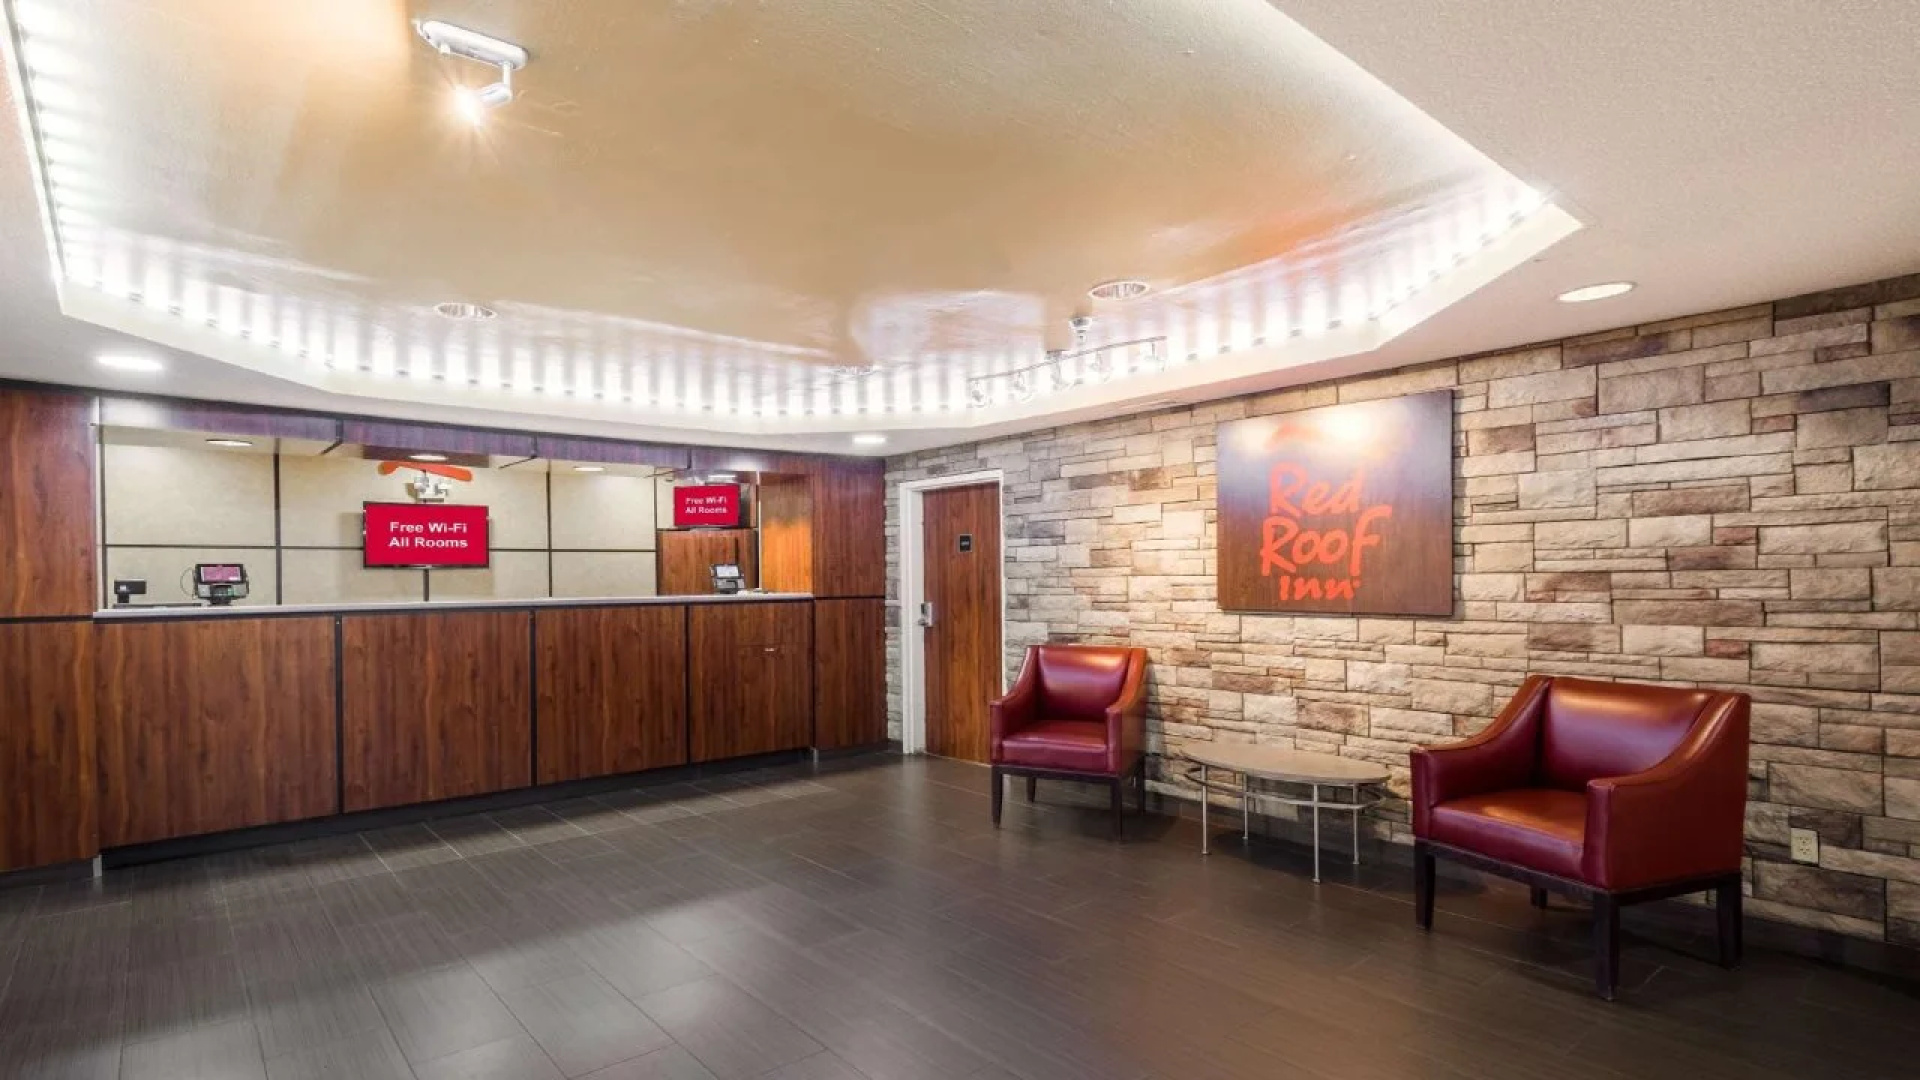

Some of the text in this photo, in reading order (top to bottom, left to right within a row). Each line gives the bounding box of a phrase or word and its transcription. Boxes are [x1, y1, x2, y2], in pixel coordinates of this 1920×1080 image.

[1269, 461, 1365, 516] Red
[685, 496, 727, 505] Free Wi-Fi
[685, 506, 727, 514] All Rooms
[389, 521, 468, 533] Free Wi-Fi
[388, 536, 468, 548] All Rooms
[1260, 504, 1393, 577] Roof
